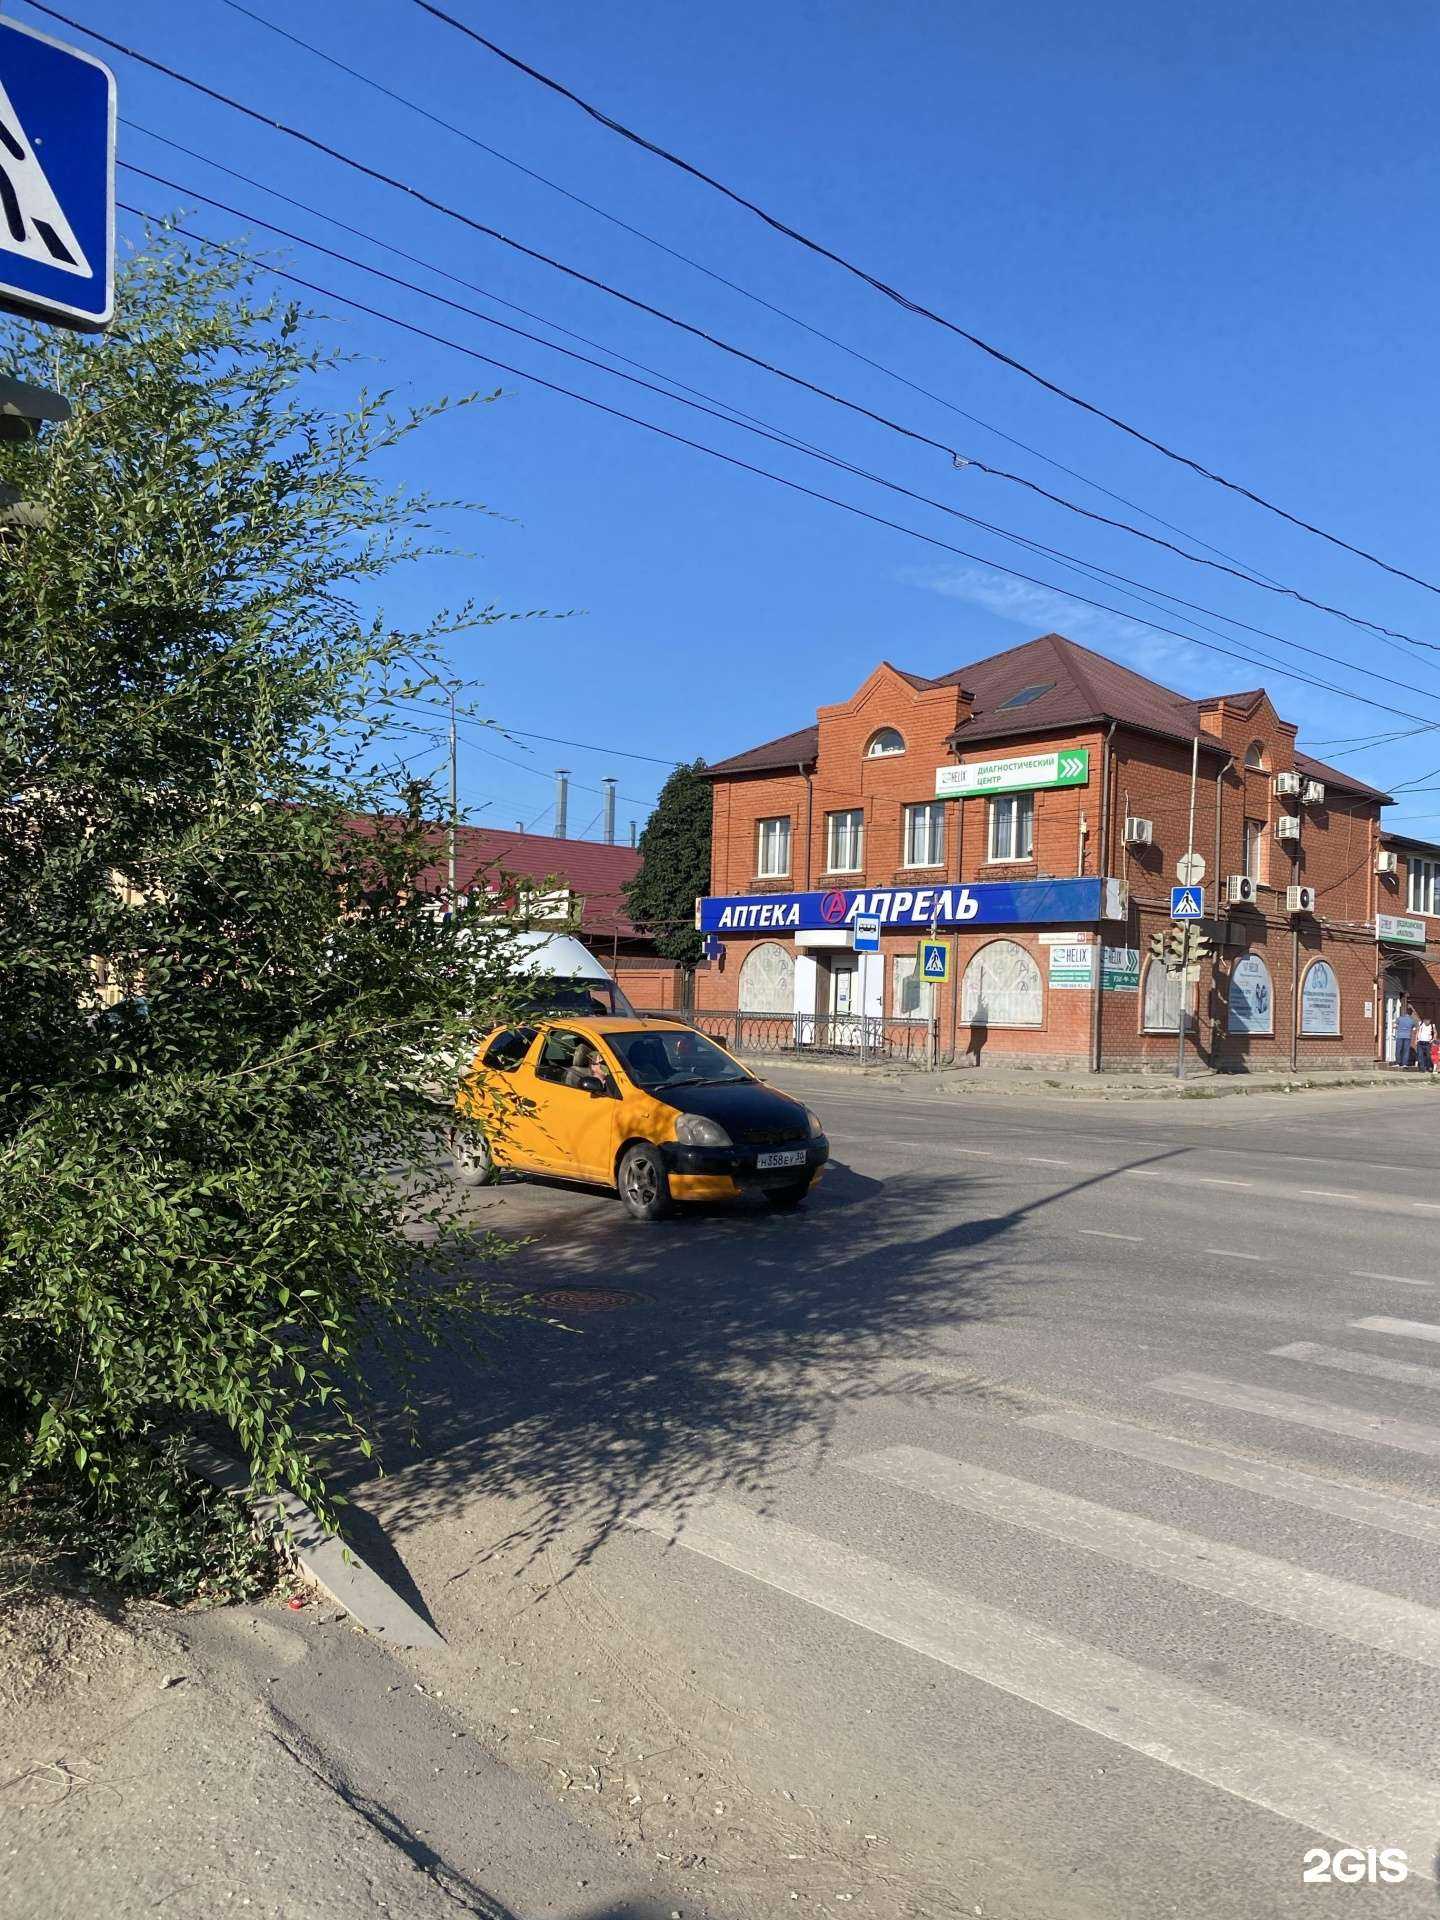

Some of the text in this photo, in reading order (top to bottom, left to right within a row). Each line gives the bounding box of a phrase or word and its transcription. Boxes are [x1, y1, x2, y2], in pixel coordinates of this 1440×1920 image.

[977, 757, 1055, 775] ДИАГНОСТИЧЕСКИЙ
[977, 775, 1002, 786] ЦЕНТР
[718, 902, 800, 928] АПТЕКА
[845, 888, 979, 924] АПРЕЛЬ
[1066, 948, 1087, 963] HELIX
